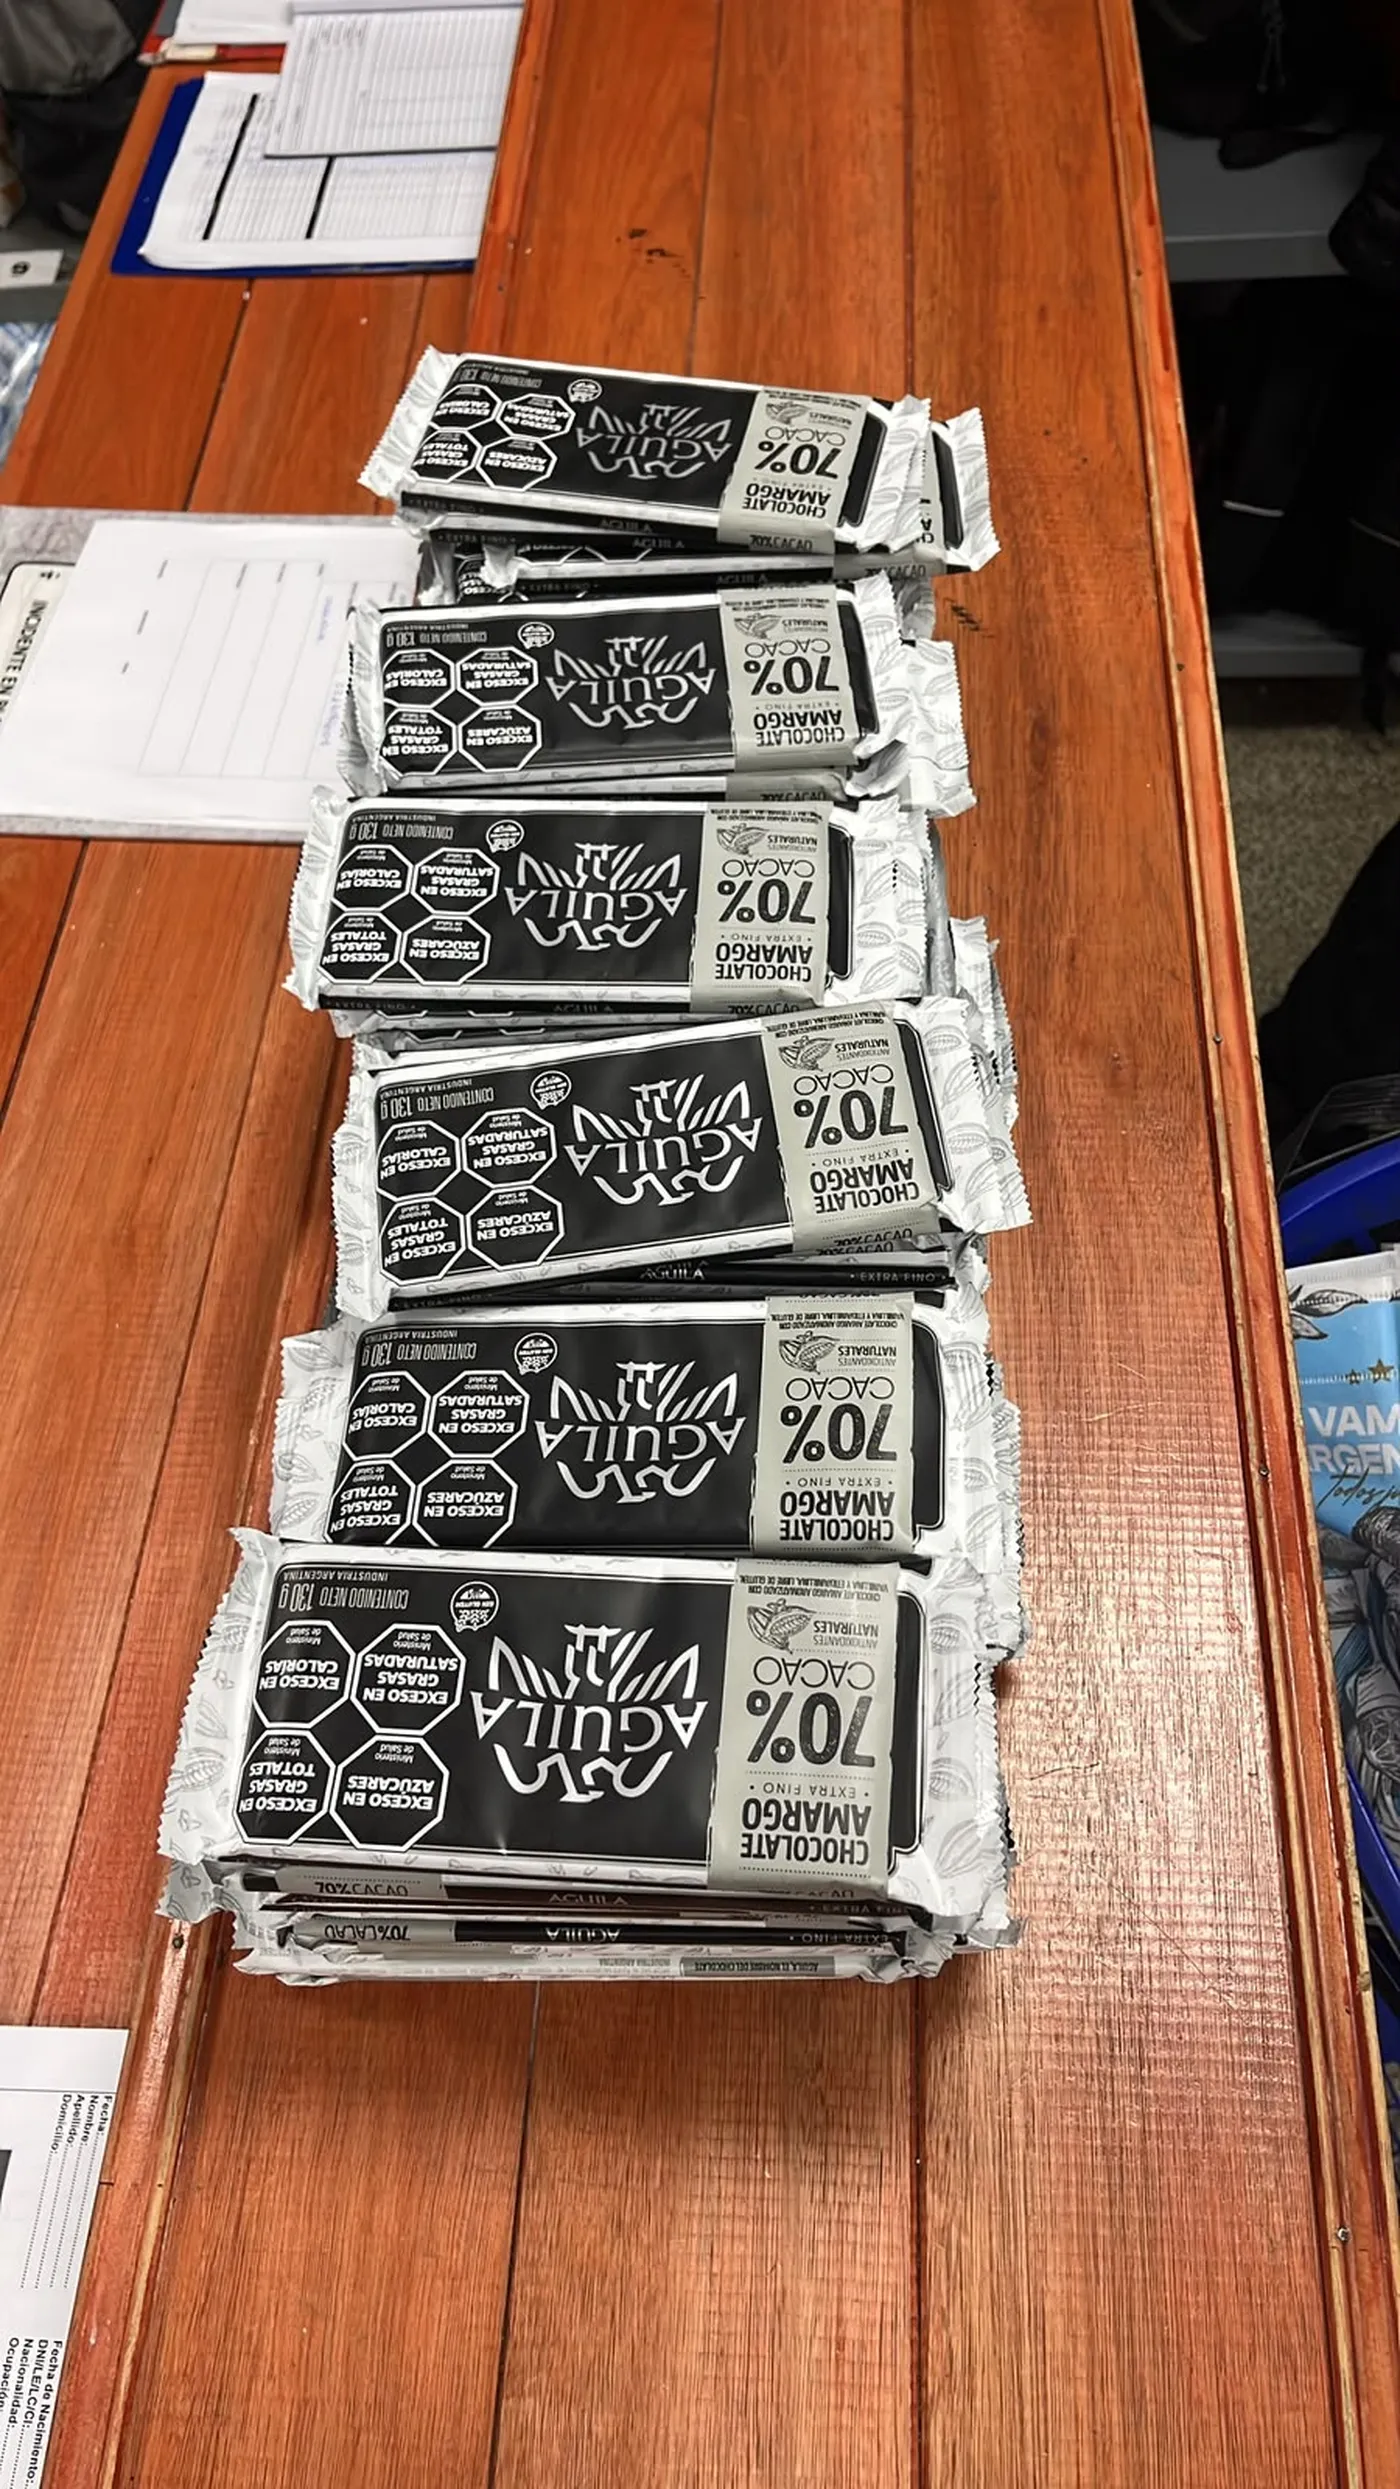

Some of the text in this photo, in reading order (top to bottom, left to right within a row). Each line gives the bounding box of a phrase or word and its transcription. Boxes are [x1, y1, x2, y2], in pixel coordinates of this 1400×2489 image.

[575, 427, 732, 462] AGUILA
[764, 426, 846, 447] CACAO
[754, 440, 838, 479] 70%
[745, 482, 832, 506] AMARGO
[741, 497, 827, 519] CHOCOLATE
[743, 638, 832, 658] CACAO
[542, 668, 716, 704] AGUILA
[741, 656, 840, 698] 70%
[751, 710, 844, 730] AMARGO
[754, 727, 847, 744] CHOCOLATE
[359, 823, 378, 841] 130
[767, 835, 818, 845] NATURALES
[721, 858, 815, 877] CACAO
[502, 885, 687, 920] AGUILA
[716, 879, 816, 924] 70%
[730, 933, 802, 942] EXTRA FINO
[715, 943, 813, 963] AMARGO
[714, 964, 812, 980] CHOCOLATE
[833, 1038, 890, 1052] NATURALES
[791, 1062, 896, 1097] CACAO
[379, 1087, 495, 1119] CONTENIDO NETO 130 g
[790, 1086, 909, 1150] 70%
[467, 1125, 549, 1147] SATURADAS
[382, 1144, 447, 1167] CALORÍAS
[481, 1139, 536, 1156] GRASAS
[562, 1115, 762, 1177] AGUILA
[397, 1156, 452, 1174] EXCESO
[473, 1149, 546, 1168] EXCESO EN
[821, 1149, 900, 1168] EXTRA FINO
[807, 1159, 918, 1195] AMARGO
[811, 1182, 922, 1214] CHOCOLATE
[390, 1217, 448, 1237] TOTALES
[477, 1209, 553, 1231] AZÚCARES
[393, 1229, 445, 1248] GRASAS
[475, 1221, 554, 1241] EXCESO EN
[403, 1241, 456, 1259] EXCESO
[412, 1330, 458, 1339] INDUSTRIA
[361, 1342, 477, 1365] CONTENIDO NETO 130 g
[837, 1346, 897, 1357] NATURALES
[785, 1376, 895, 1401] CACAO
[350, 1402, 416, 1418] CALORÍAS
[438, 1394, 523, 1407] SATURADAS
[364, 1416, 418, 1428] EXCESO
[451, 1408, 506, 1419] GRASAS
[438, 1422, 515, 1433] EXCESO EN
[779, 1403, 897, 1464] 70%
[532, 1416, 746, 1463] AGUILA
[796, 1477, 881, 1487] EXTRA FINO
[340, 1486, 399, 1500] TOTALES
[427, 1491, 505, 1505] AZÚCARES
[340, 1499, 392, 1513] GRASAS
[423, 1504, 504, 1516] EXCESO EN
[779, 1491, 895, 1517] AMARGO
[347, 1514, 401, 1527] EXCESO
[778, 1519, 895, 1539] CHOCOLATE
[283, 1570, 388, 1582] INDUSTRIA ARGENTINA
[278, 1583, 409, 1612] CONTENIDO NETO 130 g
[397, 1631, 421, 1641] Salud
[813, 1620, 879, 1638] NATURALES
[392, 1639, 431, 1651] Ministerio
[264, 1659, 338, 1676] CALORÍAS
[364, 1653, 459, 1671] SATURADAS
[279, 1674, 340, 1690] EXCESO
[377, 1671, 439, 1686] GRASAS
[753, 1655, 875, 1691] CACAO
[362, 1687, 449, 1704] EXCESO EN
[469, 1691, 708, 1753] AGUILA
[745, 1689, 875, 1768] 70%
[374, 1752, 414, 1763] Ministerio
[380, 1743, 404, 1754] Salud
[249, 1762, 316, 1777] TOTALES
[249, 1779, 308, 1794] GRASAS
[347, 1774, 435, 1794] AZÚCARES
[762, 1782, 856, 1799] EXTRA FINO
[256, 1796, 317, 1812] EXCESO
[342, 1791, 434, 1810] EXCESO EN
[741, 1797, 871, 1836] AMARGO
[740, 1833, 869, 1866] CHOCOLATE
[545, 1927, 621, 1943] AGUILA
[46, 2340, 63, 2380] Fecha
[43, 2383, 54, 2400] de
